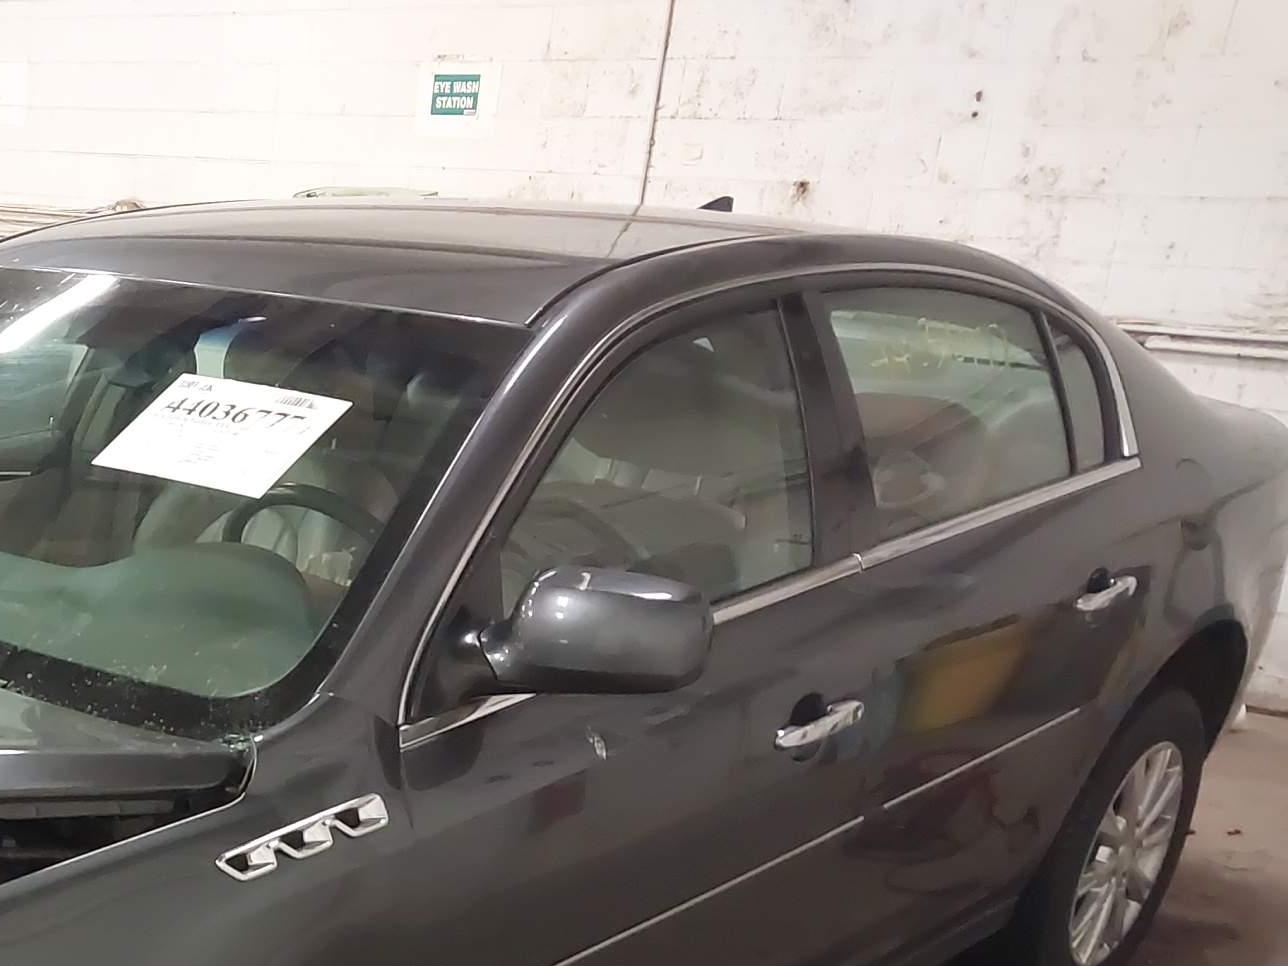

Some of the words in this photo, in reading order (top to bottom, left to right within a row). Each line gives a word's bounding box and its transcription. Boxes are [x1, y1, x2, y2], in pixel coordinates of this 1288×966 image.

[433, 81, 452, 94] EYE
[453, 80, 480, 93] WASH
[435, 96, 474, 109] STATION
